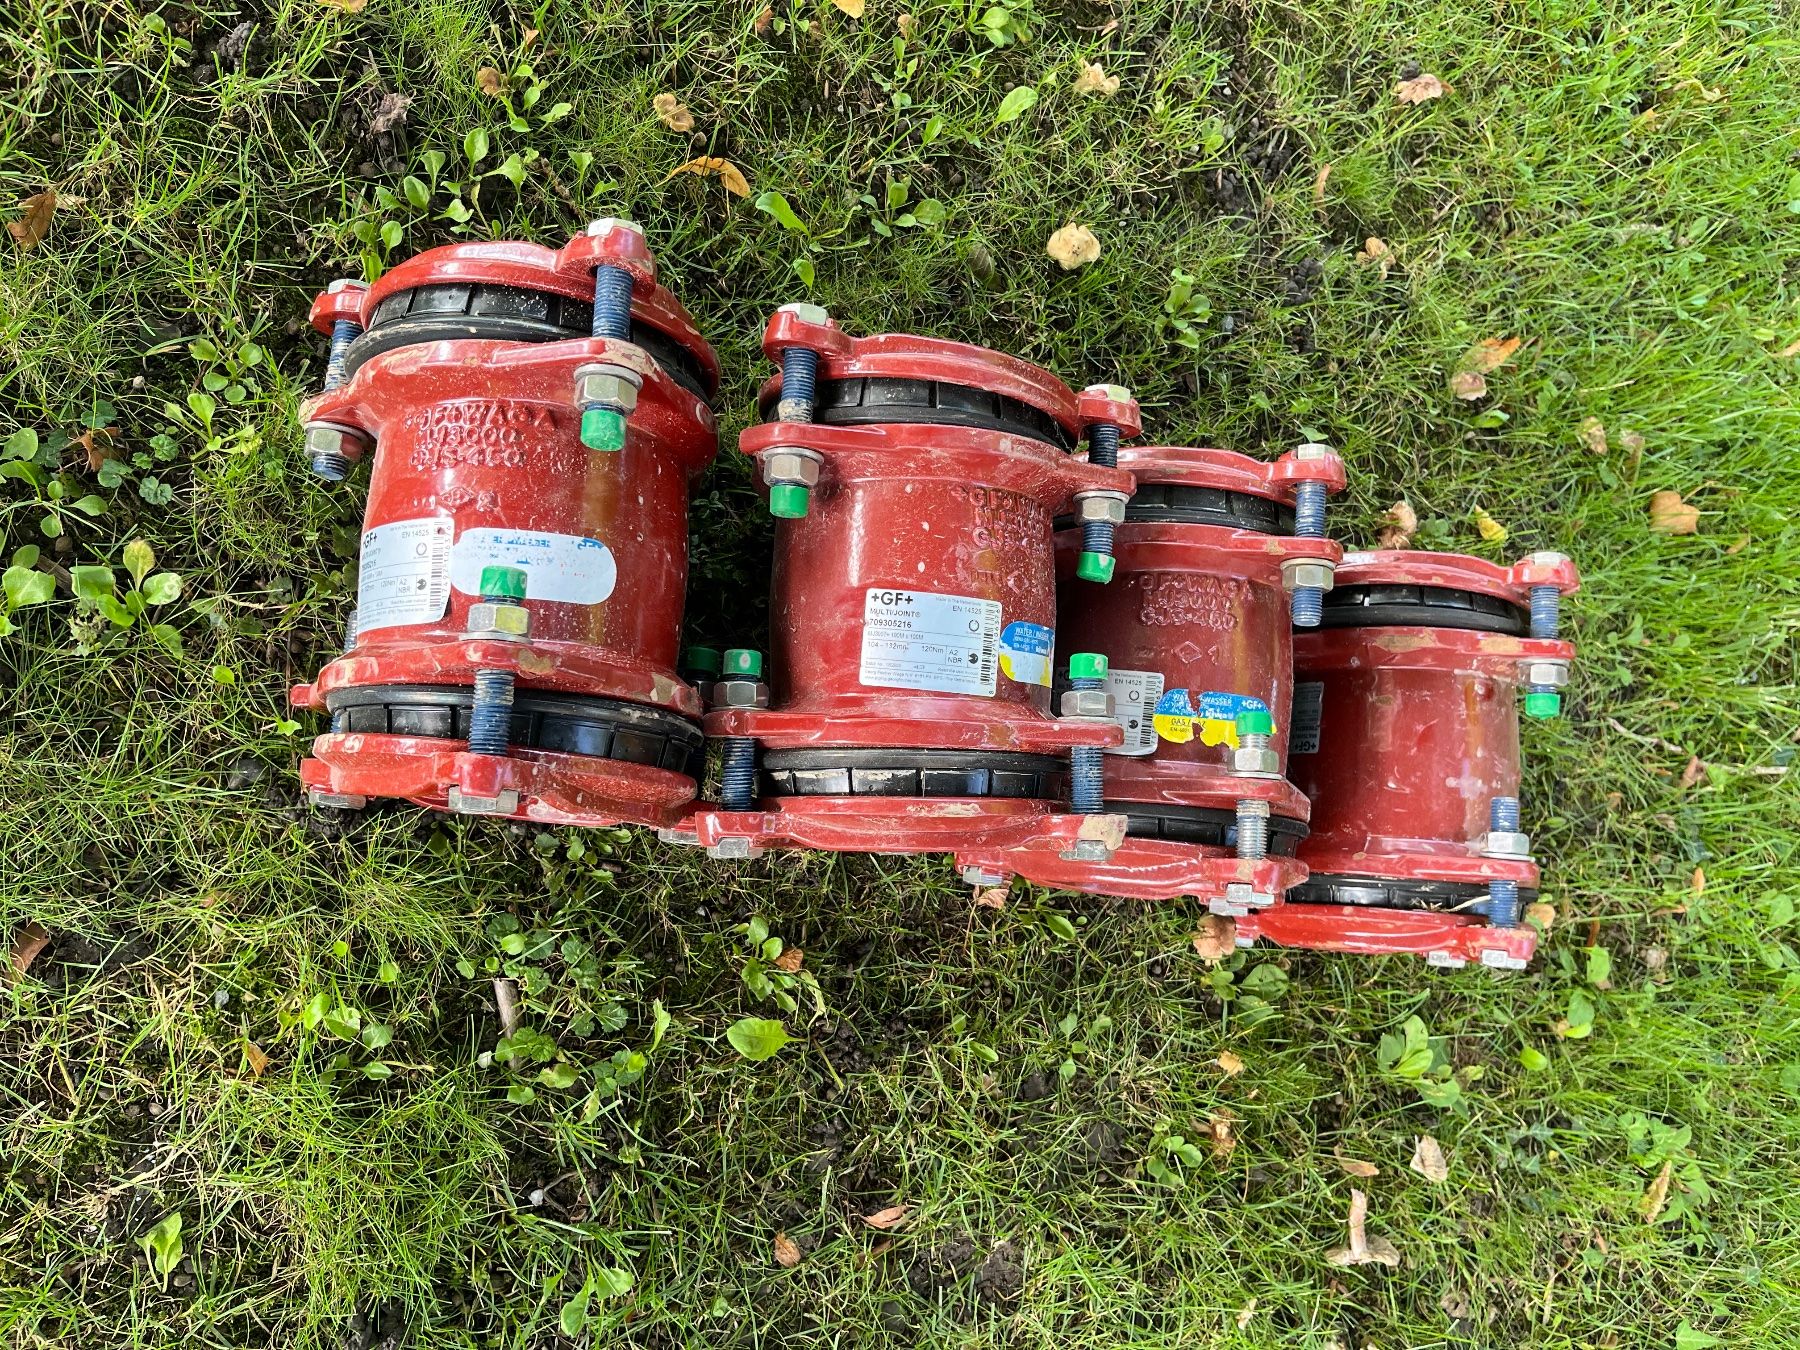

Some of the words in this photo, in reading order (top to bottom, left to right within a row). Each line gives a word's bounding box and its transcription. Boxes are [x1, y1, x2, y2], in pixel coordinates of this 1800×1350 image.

[402, 531, 411, 539] EN
[412, 528, 430, 537] 14525
[871, 591, 914, 606] +GF+
[869, 618, 912, 629] 709305216
[1171, 718, 1186, 726] GAS
